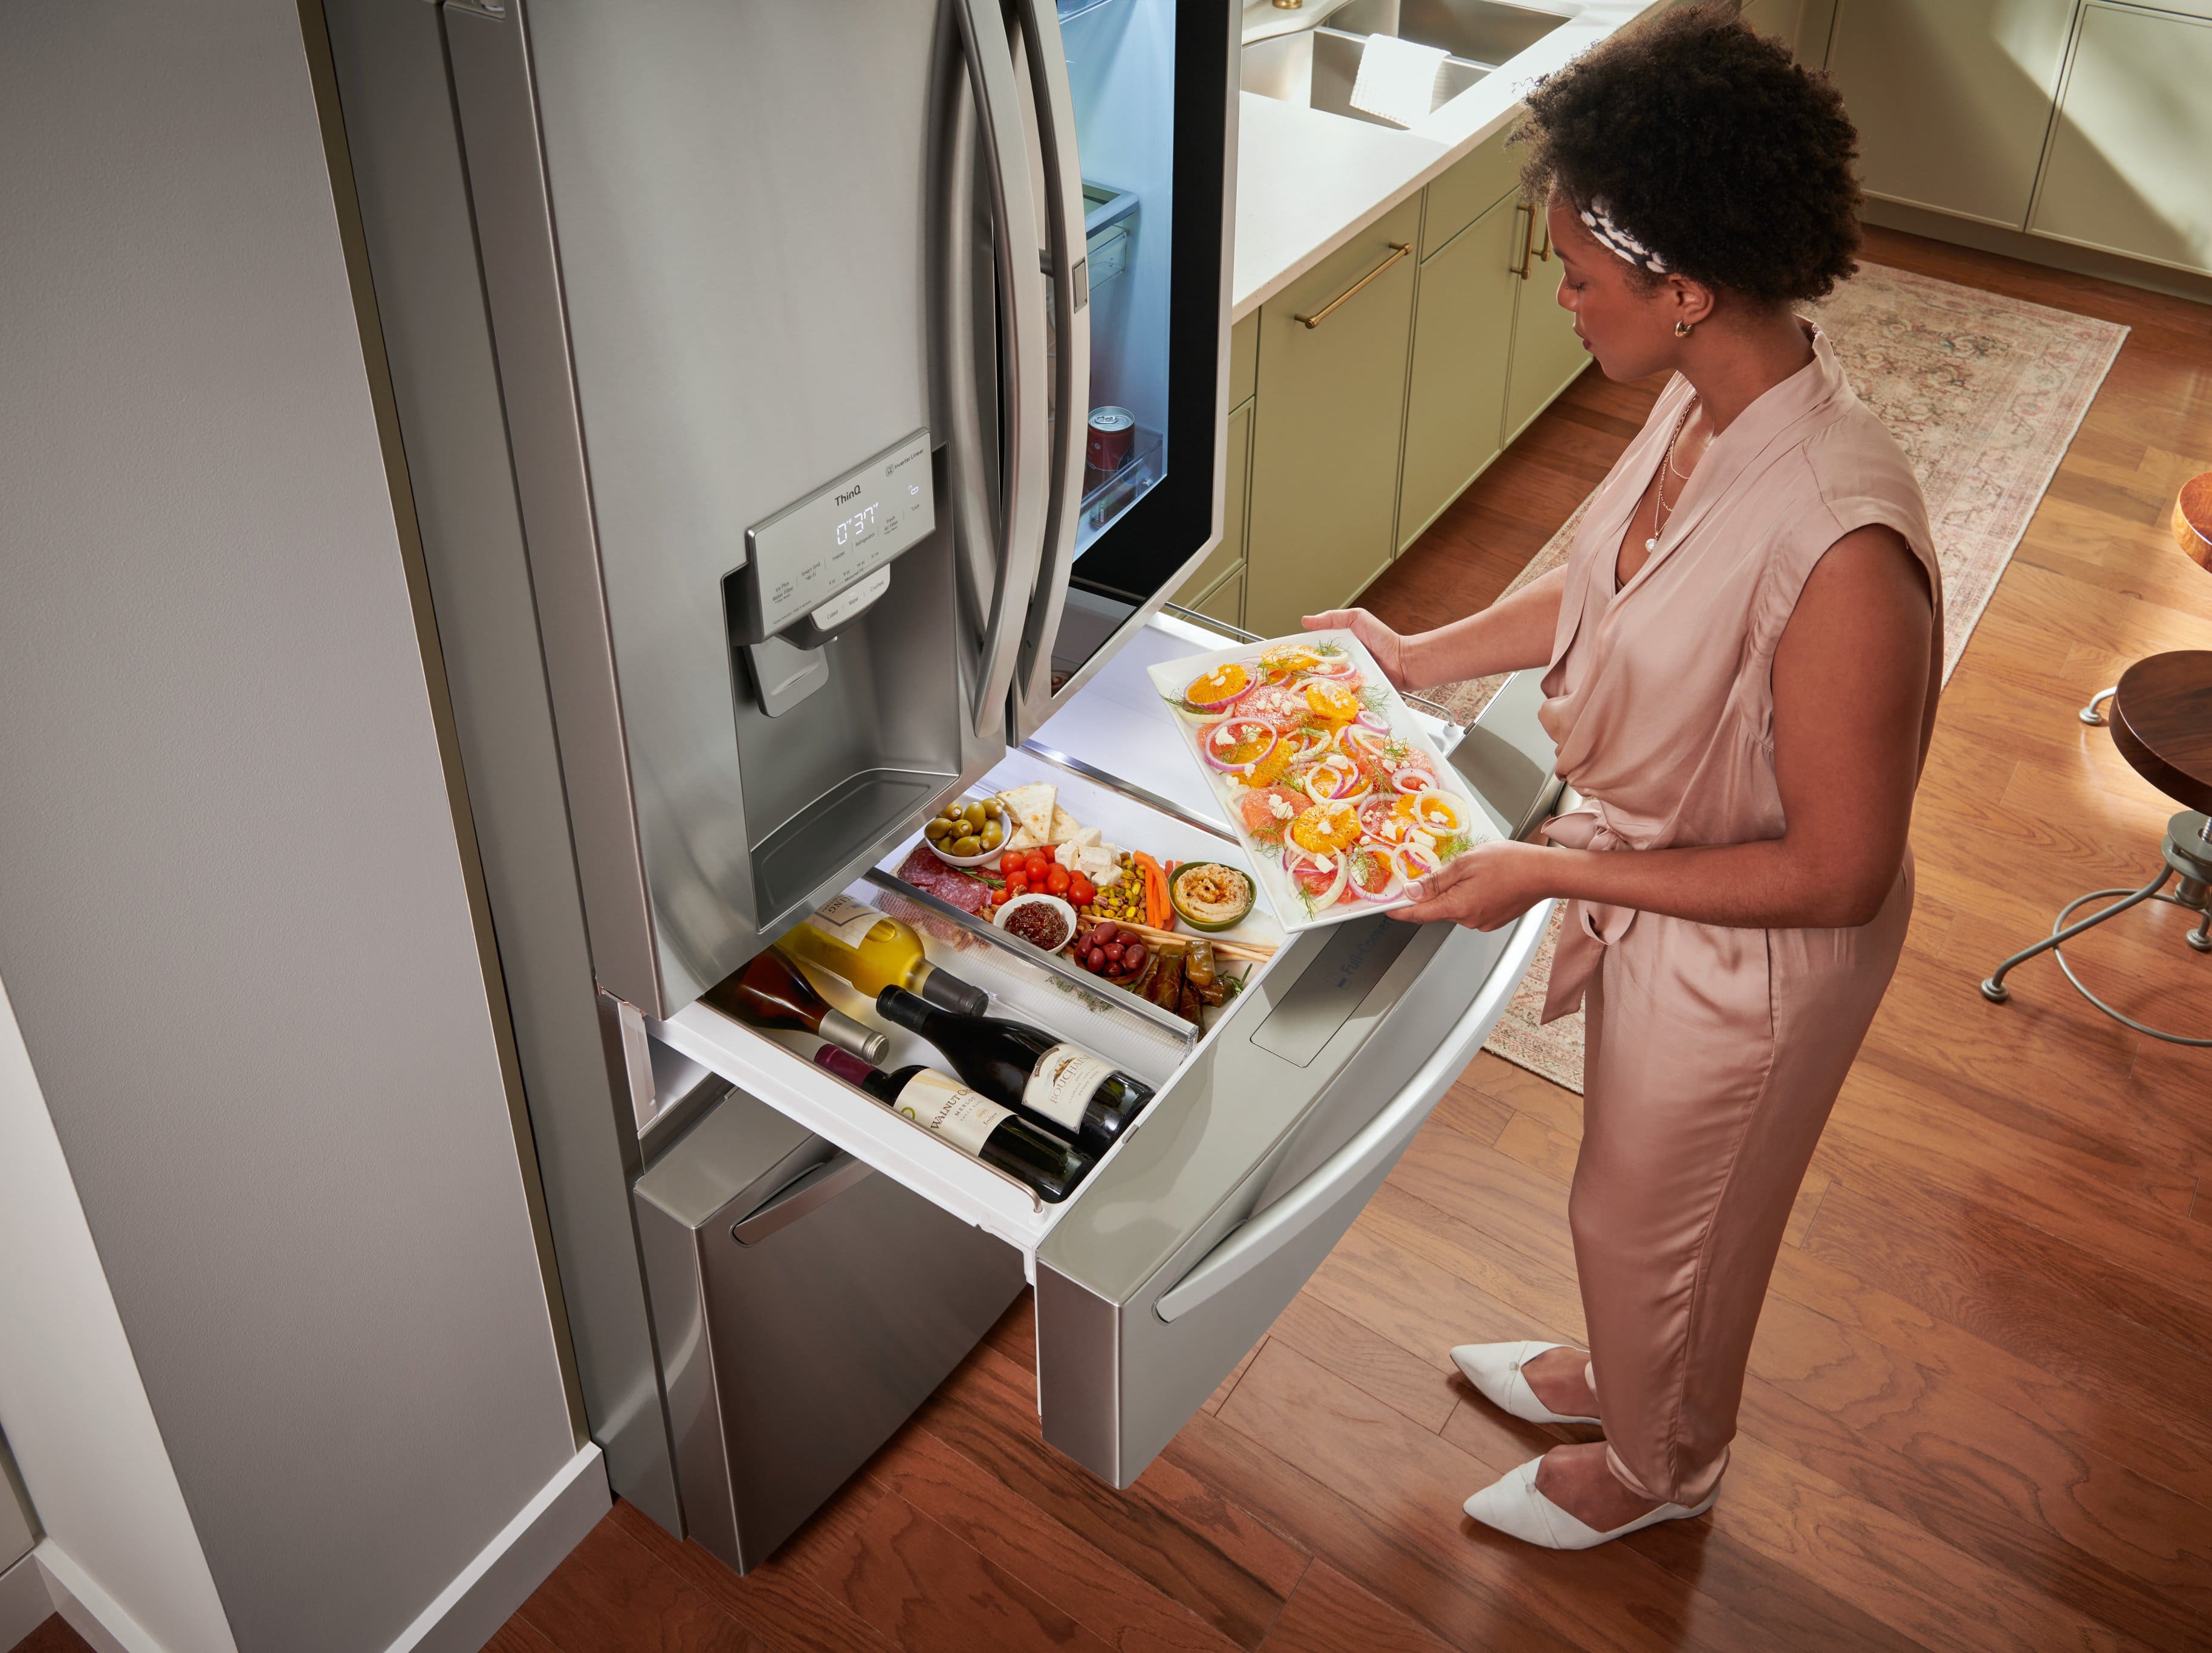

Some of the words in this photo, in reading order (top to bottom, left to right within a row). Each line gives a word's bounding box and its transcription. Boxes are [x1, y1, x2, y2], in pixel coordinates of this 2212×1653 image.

[834, 485, 861, 506] ThinQ
[930, 1094, 961, 1129] WALNUT
[955, 1096, 976, 1117] MERLOT
